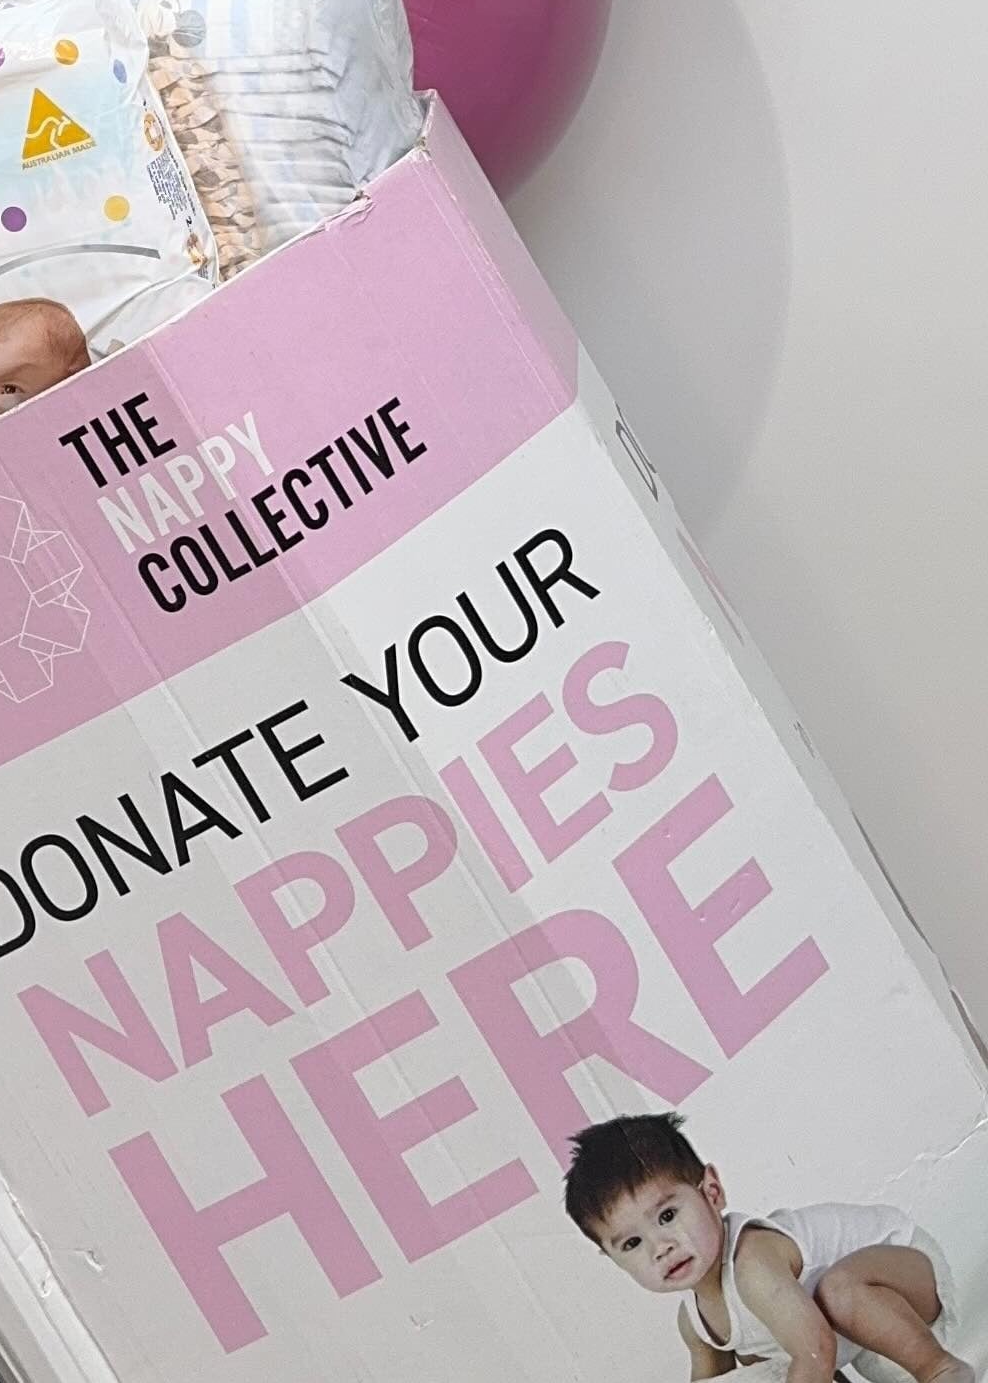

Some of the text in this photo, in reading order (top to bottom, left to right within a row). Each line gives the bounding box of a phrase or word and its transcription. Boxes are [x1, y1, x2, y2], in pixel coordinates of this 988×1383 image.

[22, 140, 98, 170] AUSTRALIAN MADE
[58, 392, 177, 488] THE
[97, 411, 274, 554] NAPPY
[138, 397, 427, 613] COLLECTIVE
[340, 527, 601, 743] YOUR
[16, 640, 679, 1118] NAPPIES
[107, 772, 831, 1354] HERE
